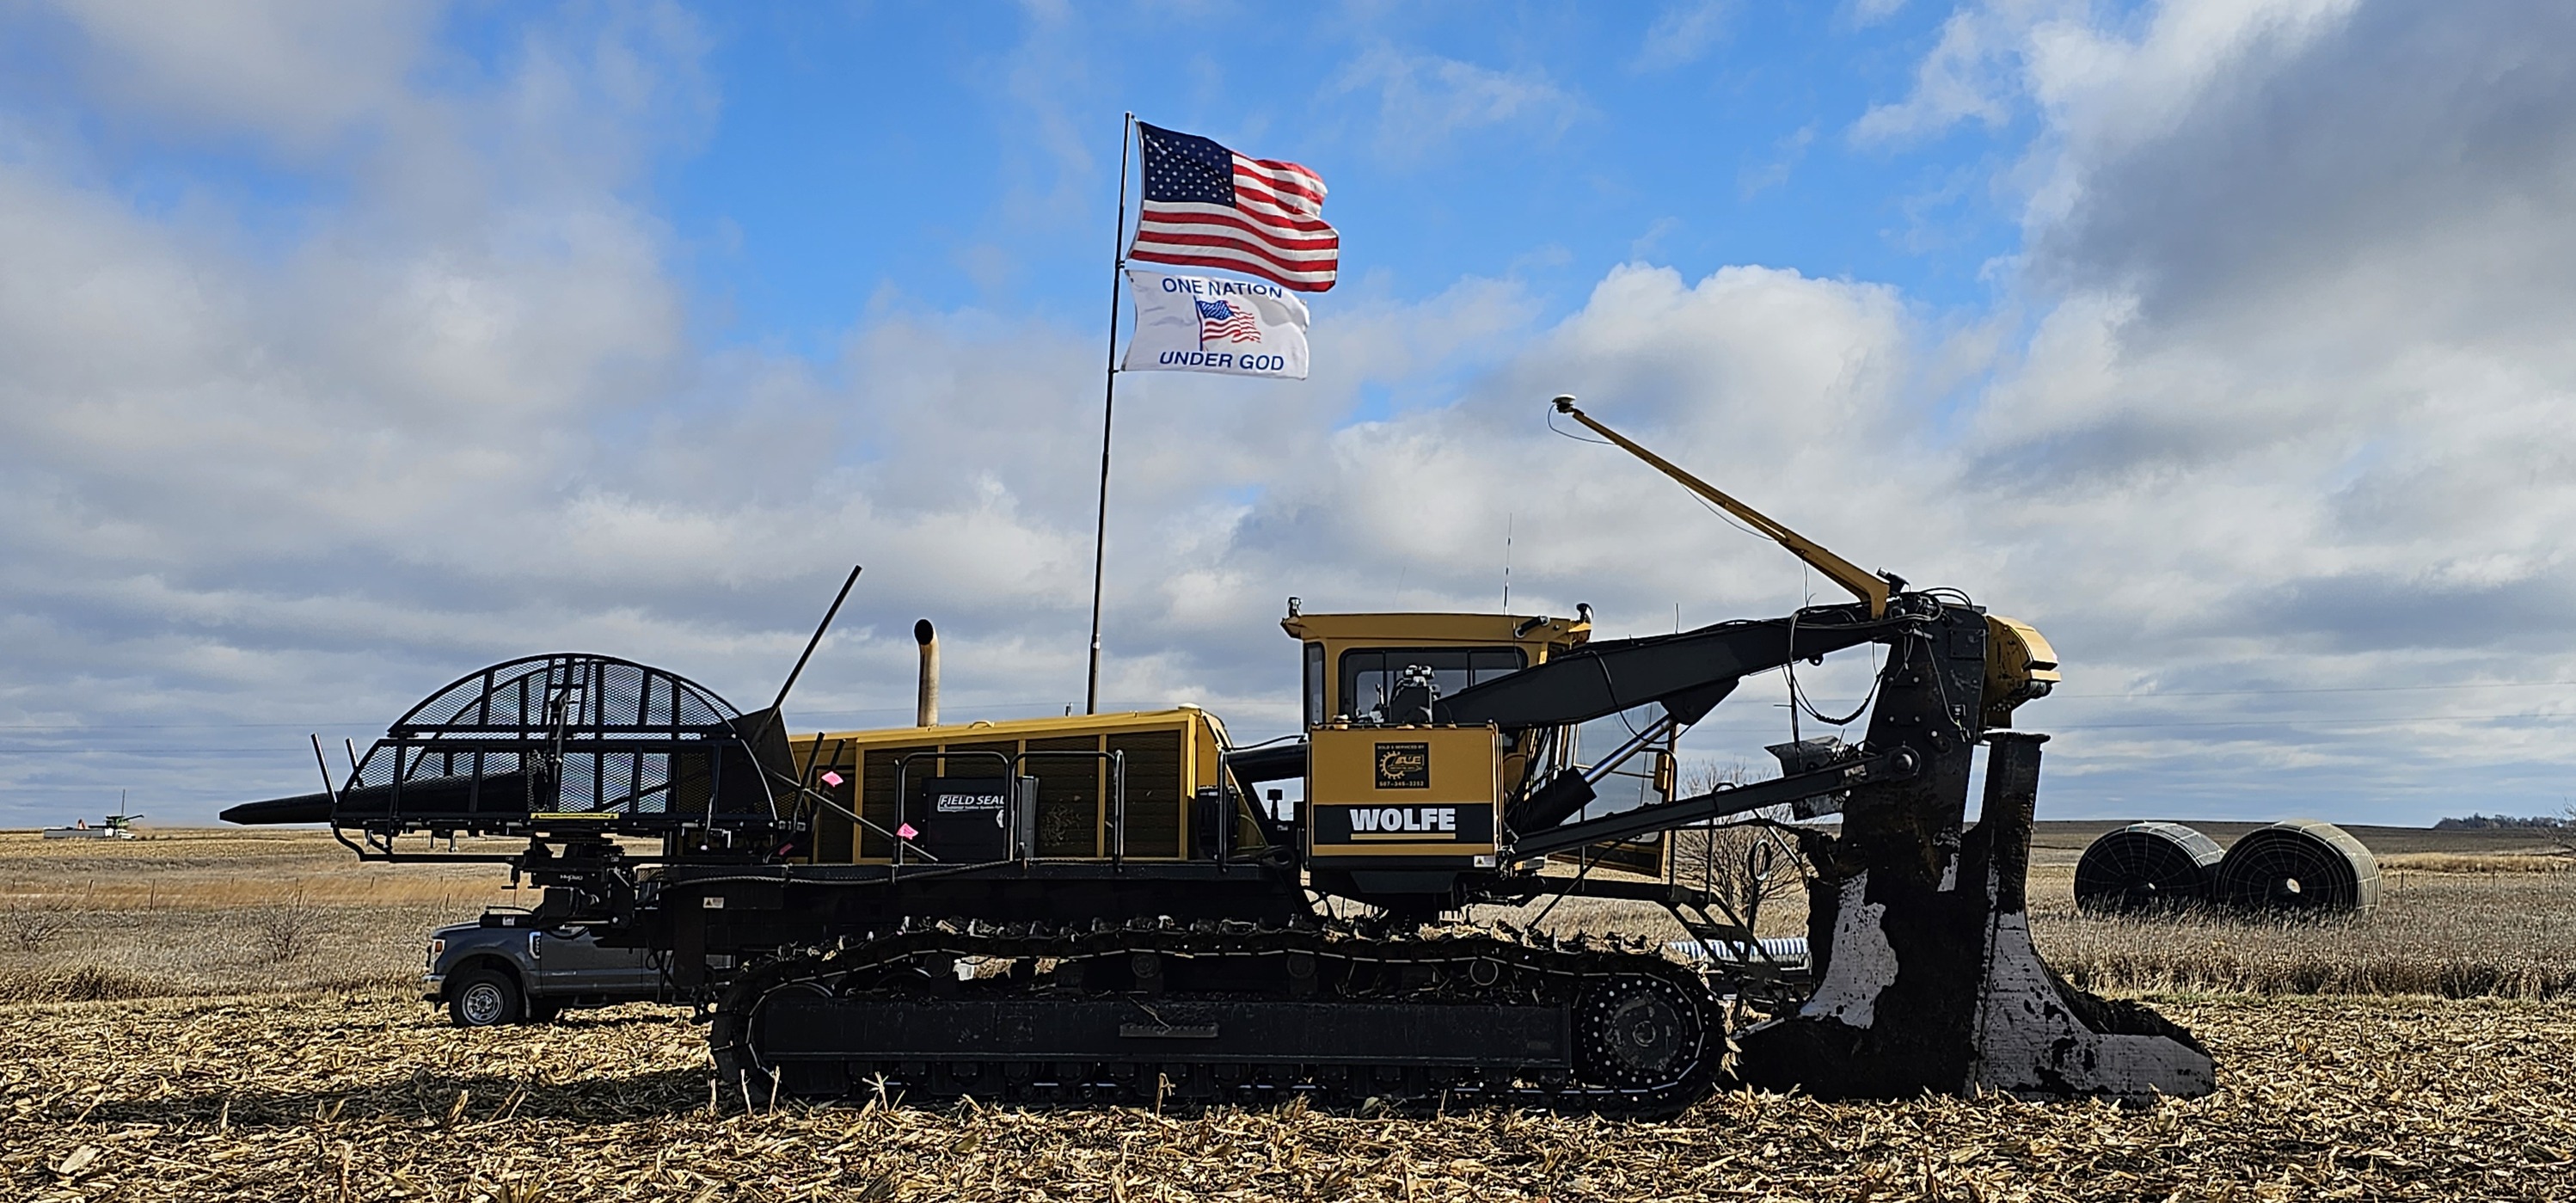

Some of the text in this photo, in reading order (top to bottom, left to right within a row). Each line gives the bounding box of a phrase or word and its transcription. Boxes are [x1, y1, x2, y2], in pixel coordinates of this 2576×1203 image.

[1162, 278, 1283, 298] ONE NATION
[1160, 352, 1284, 371] UNDER GOD
[940, 795, 1004, 805] FIELD SEAL
[1349, 808, 1456, 832] WOLFE
